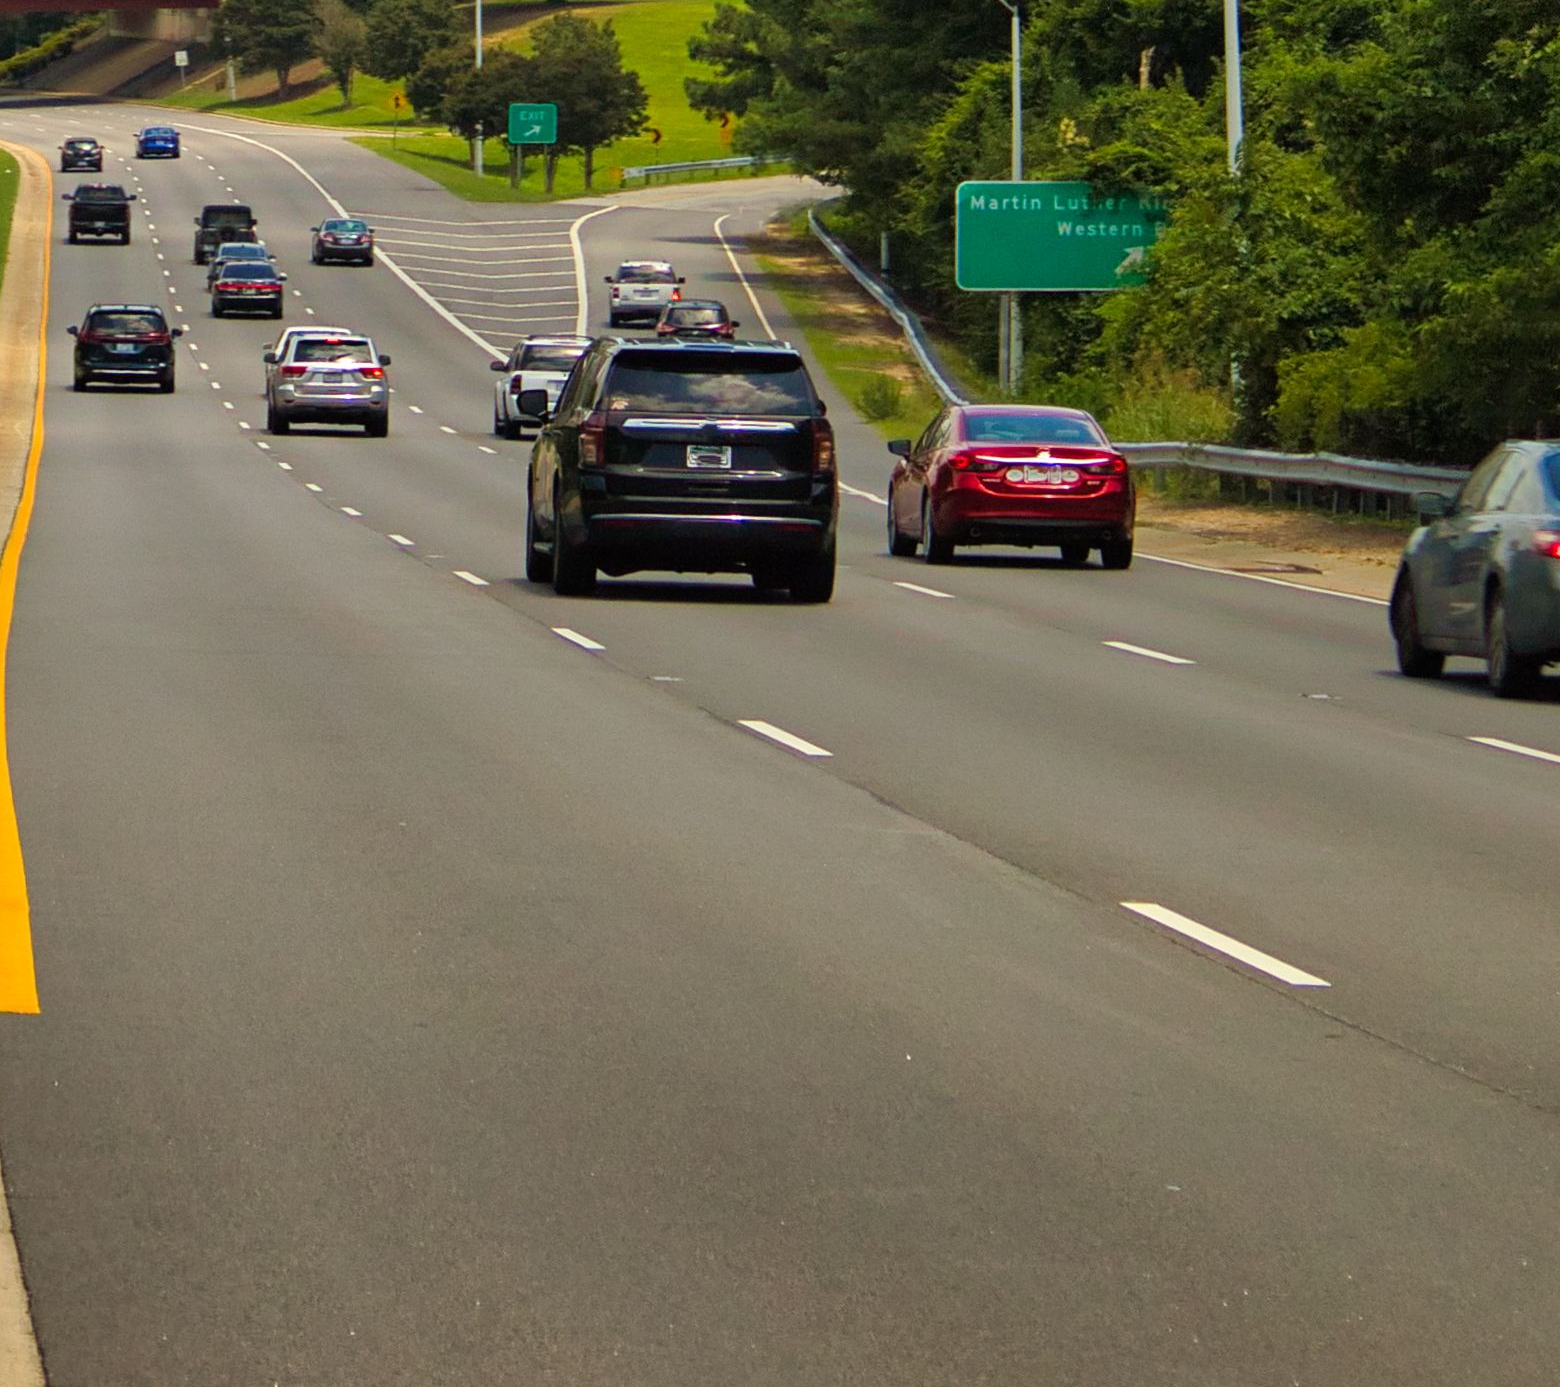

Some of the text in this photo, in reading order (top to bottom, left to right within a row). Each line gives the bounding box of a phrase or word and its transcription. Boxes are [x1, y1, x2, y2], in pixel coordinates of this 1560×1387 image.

[519, 110, 545, 121] EXIT
[969, 194, 1042, 211] Martin
[1054, 194, 1126, 211] Luter
[1056, 220, 1143, 237] Western
